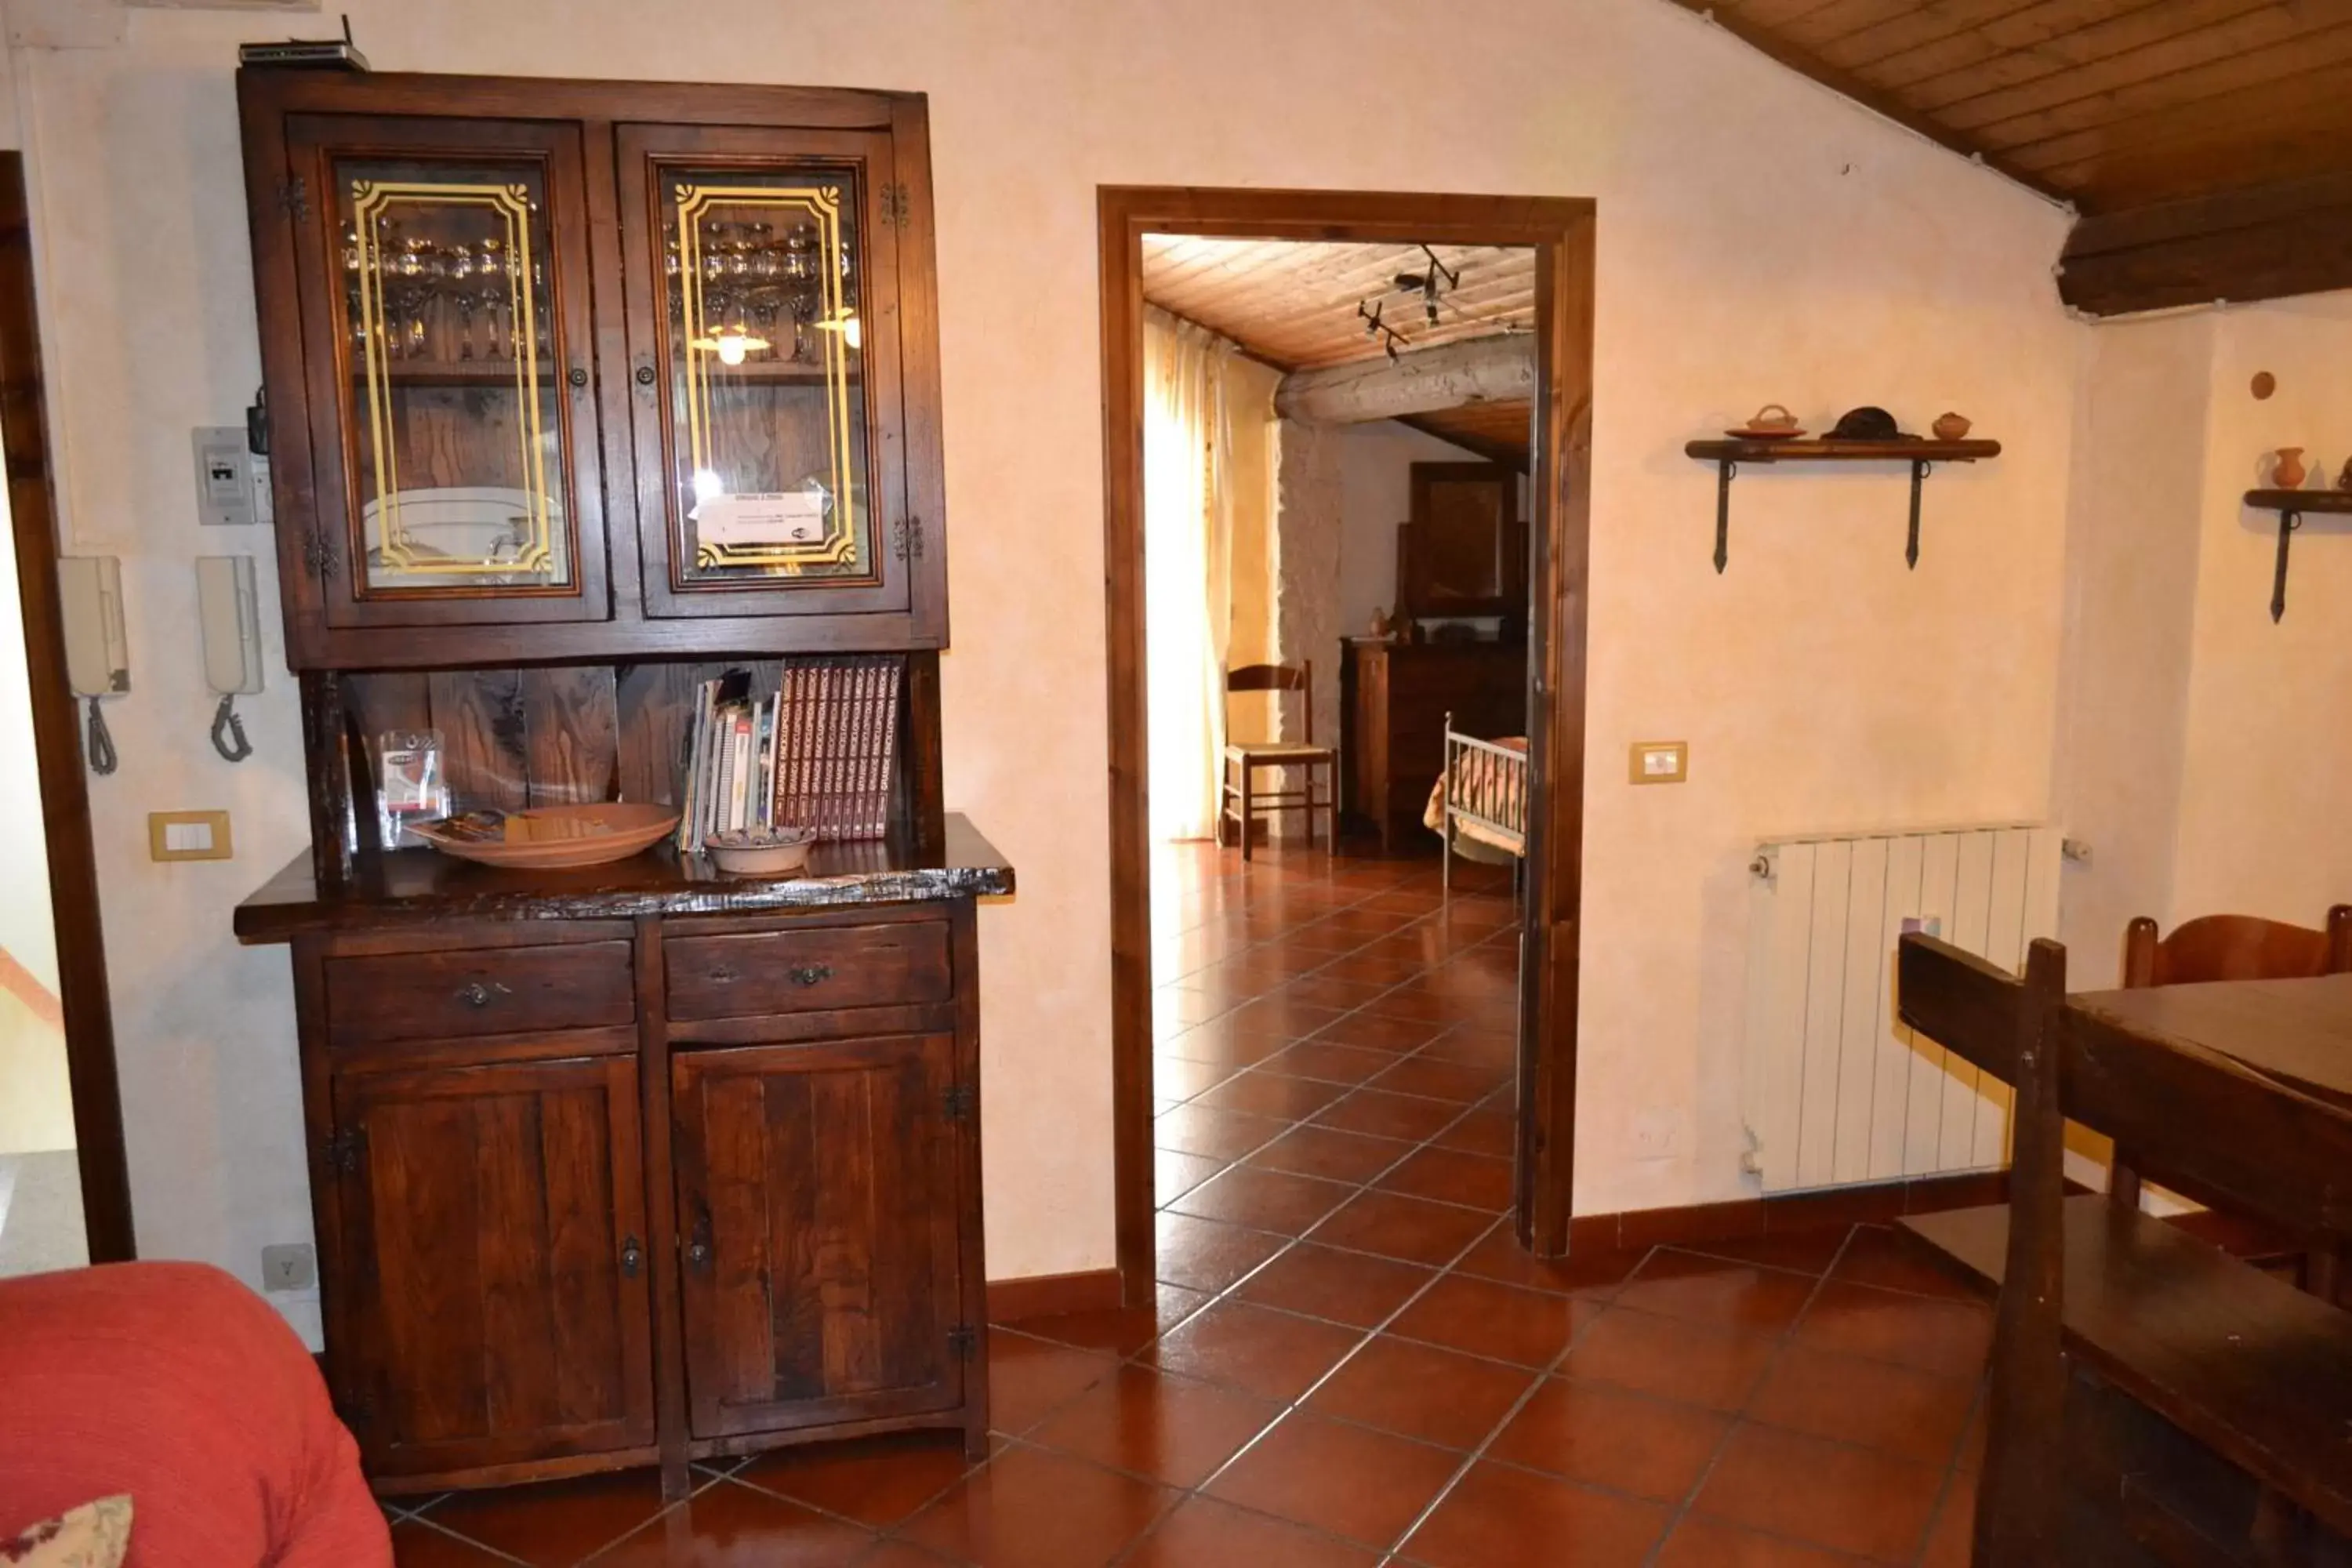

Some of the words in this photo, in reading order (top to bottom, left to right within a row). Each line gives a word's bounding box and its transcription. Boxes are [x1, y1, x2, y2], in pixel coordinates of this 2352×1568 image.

[777, 760, 786, 796] GRANDE
[783, 669, 793, 700] MEDICA
[789, 760, 798, 794] GRANDE
[796, 668, 805, 699] MEDICA
[800, 760, 811, 794] GRANDE
[808, 668, 817, 699] MEDICA
[812, 760, 821, 793] GRANDE
[819, 668, 829, 699] MEDICA
[824, 760, 833, 793] GRANDE
[832, 668, 841, 699] MEDICA
[835, 760, 844, 793] GRANDE
[843, 668, 853, 699] MEDICA
[846, 758, 855, 792] GRANDE
[855, 668, 864, 699] MEDICA
[857, 758, 868, 792] GRANDE
[866, 667, 876, 698] MEDICA
[868, 757, 879, 791] GRANDE
[877, 666, 888, 698] MEDICA
[880, 757, 891, 791] GRANDE
[889, 666, 900, 697] MEDICA
